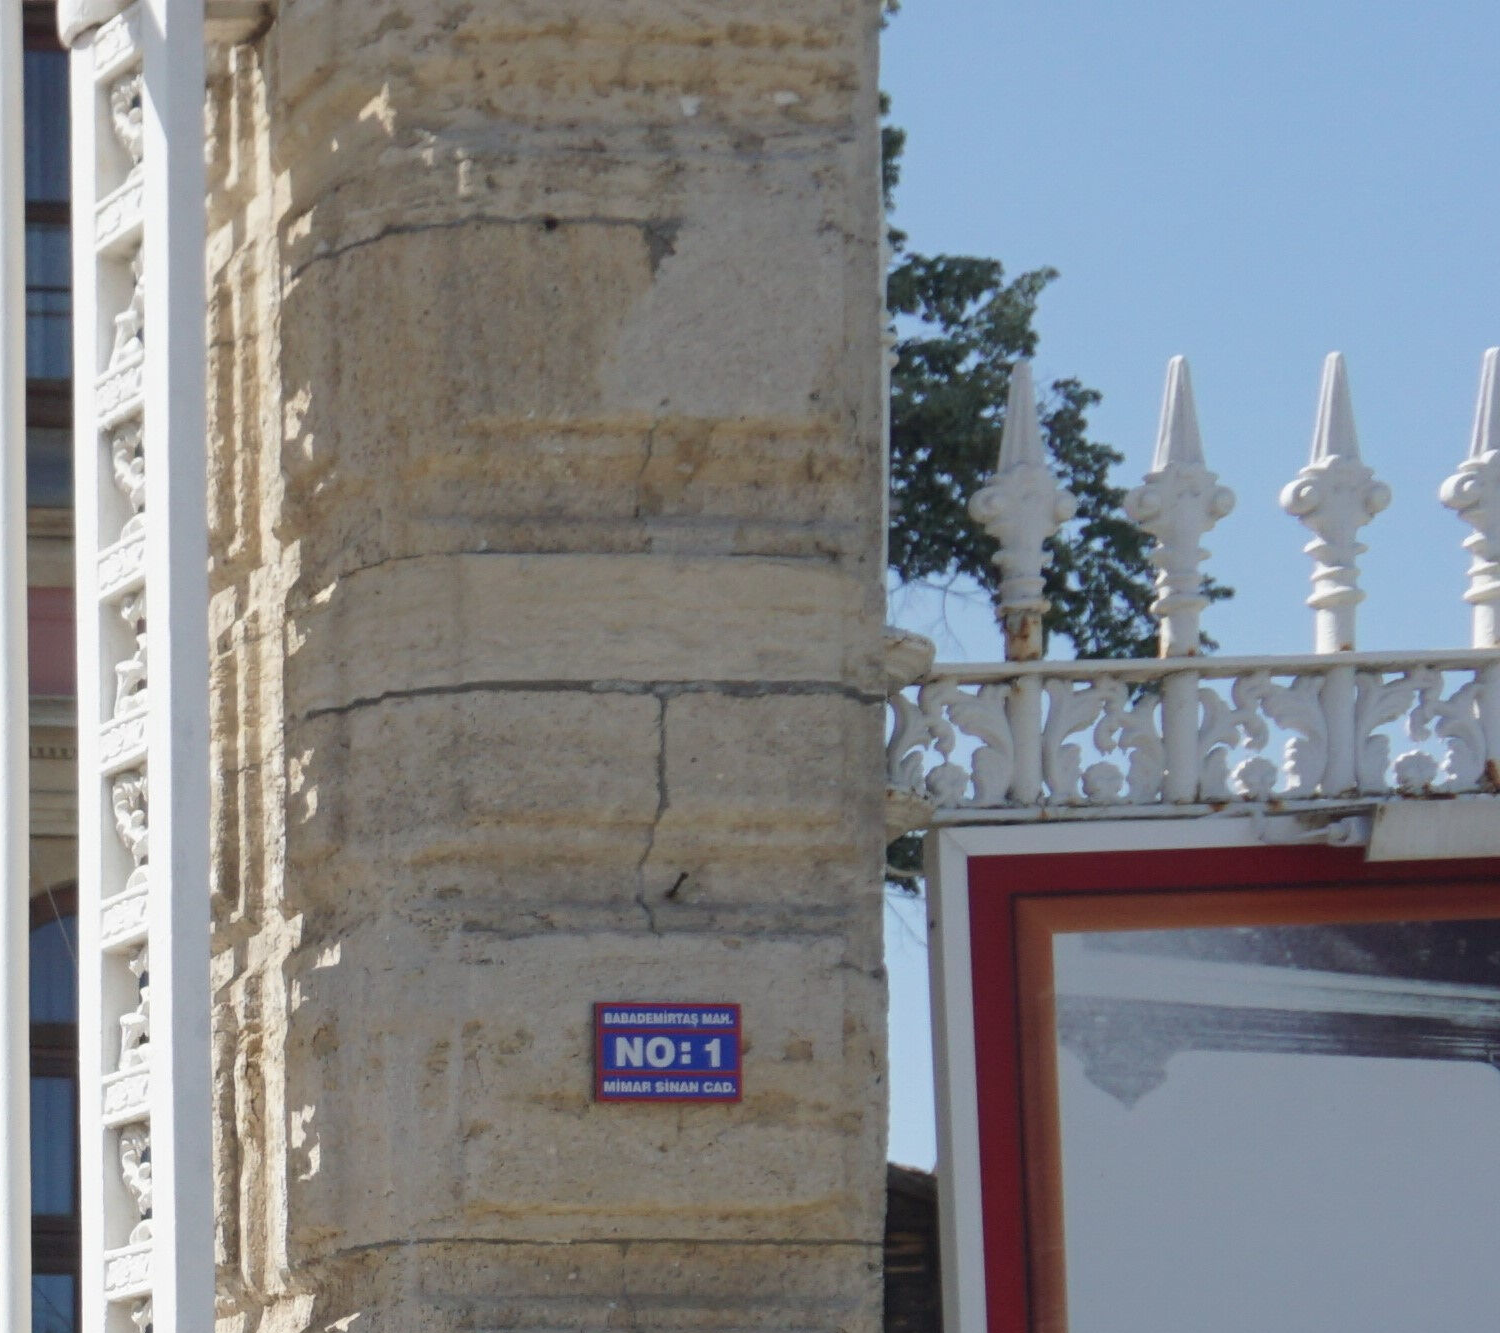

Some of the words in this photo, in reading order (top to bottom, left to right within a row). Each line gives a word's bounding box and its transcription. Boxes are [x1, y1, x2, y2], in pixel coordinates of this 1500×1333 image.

[604, 1010, 699, 1027] BABADEMİRTAŞ
[702, 1013, 733, 1025] MAH.
[615, 1036, 692, 1068] NO:
[704, 1038, 721, 1068] 1
[603, 1078, 652, 1093] MİMAR
[655, 1078, 699, 1093] SİNAN
[703, 1081, 736, 1093] CAD.
